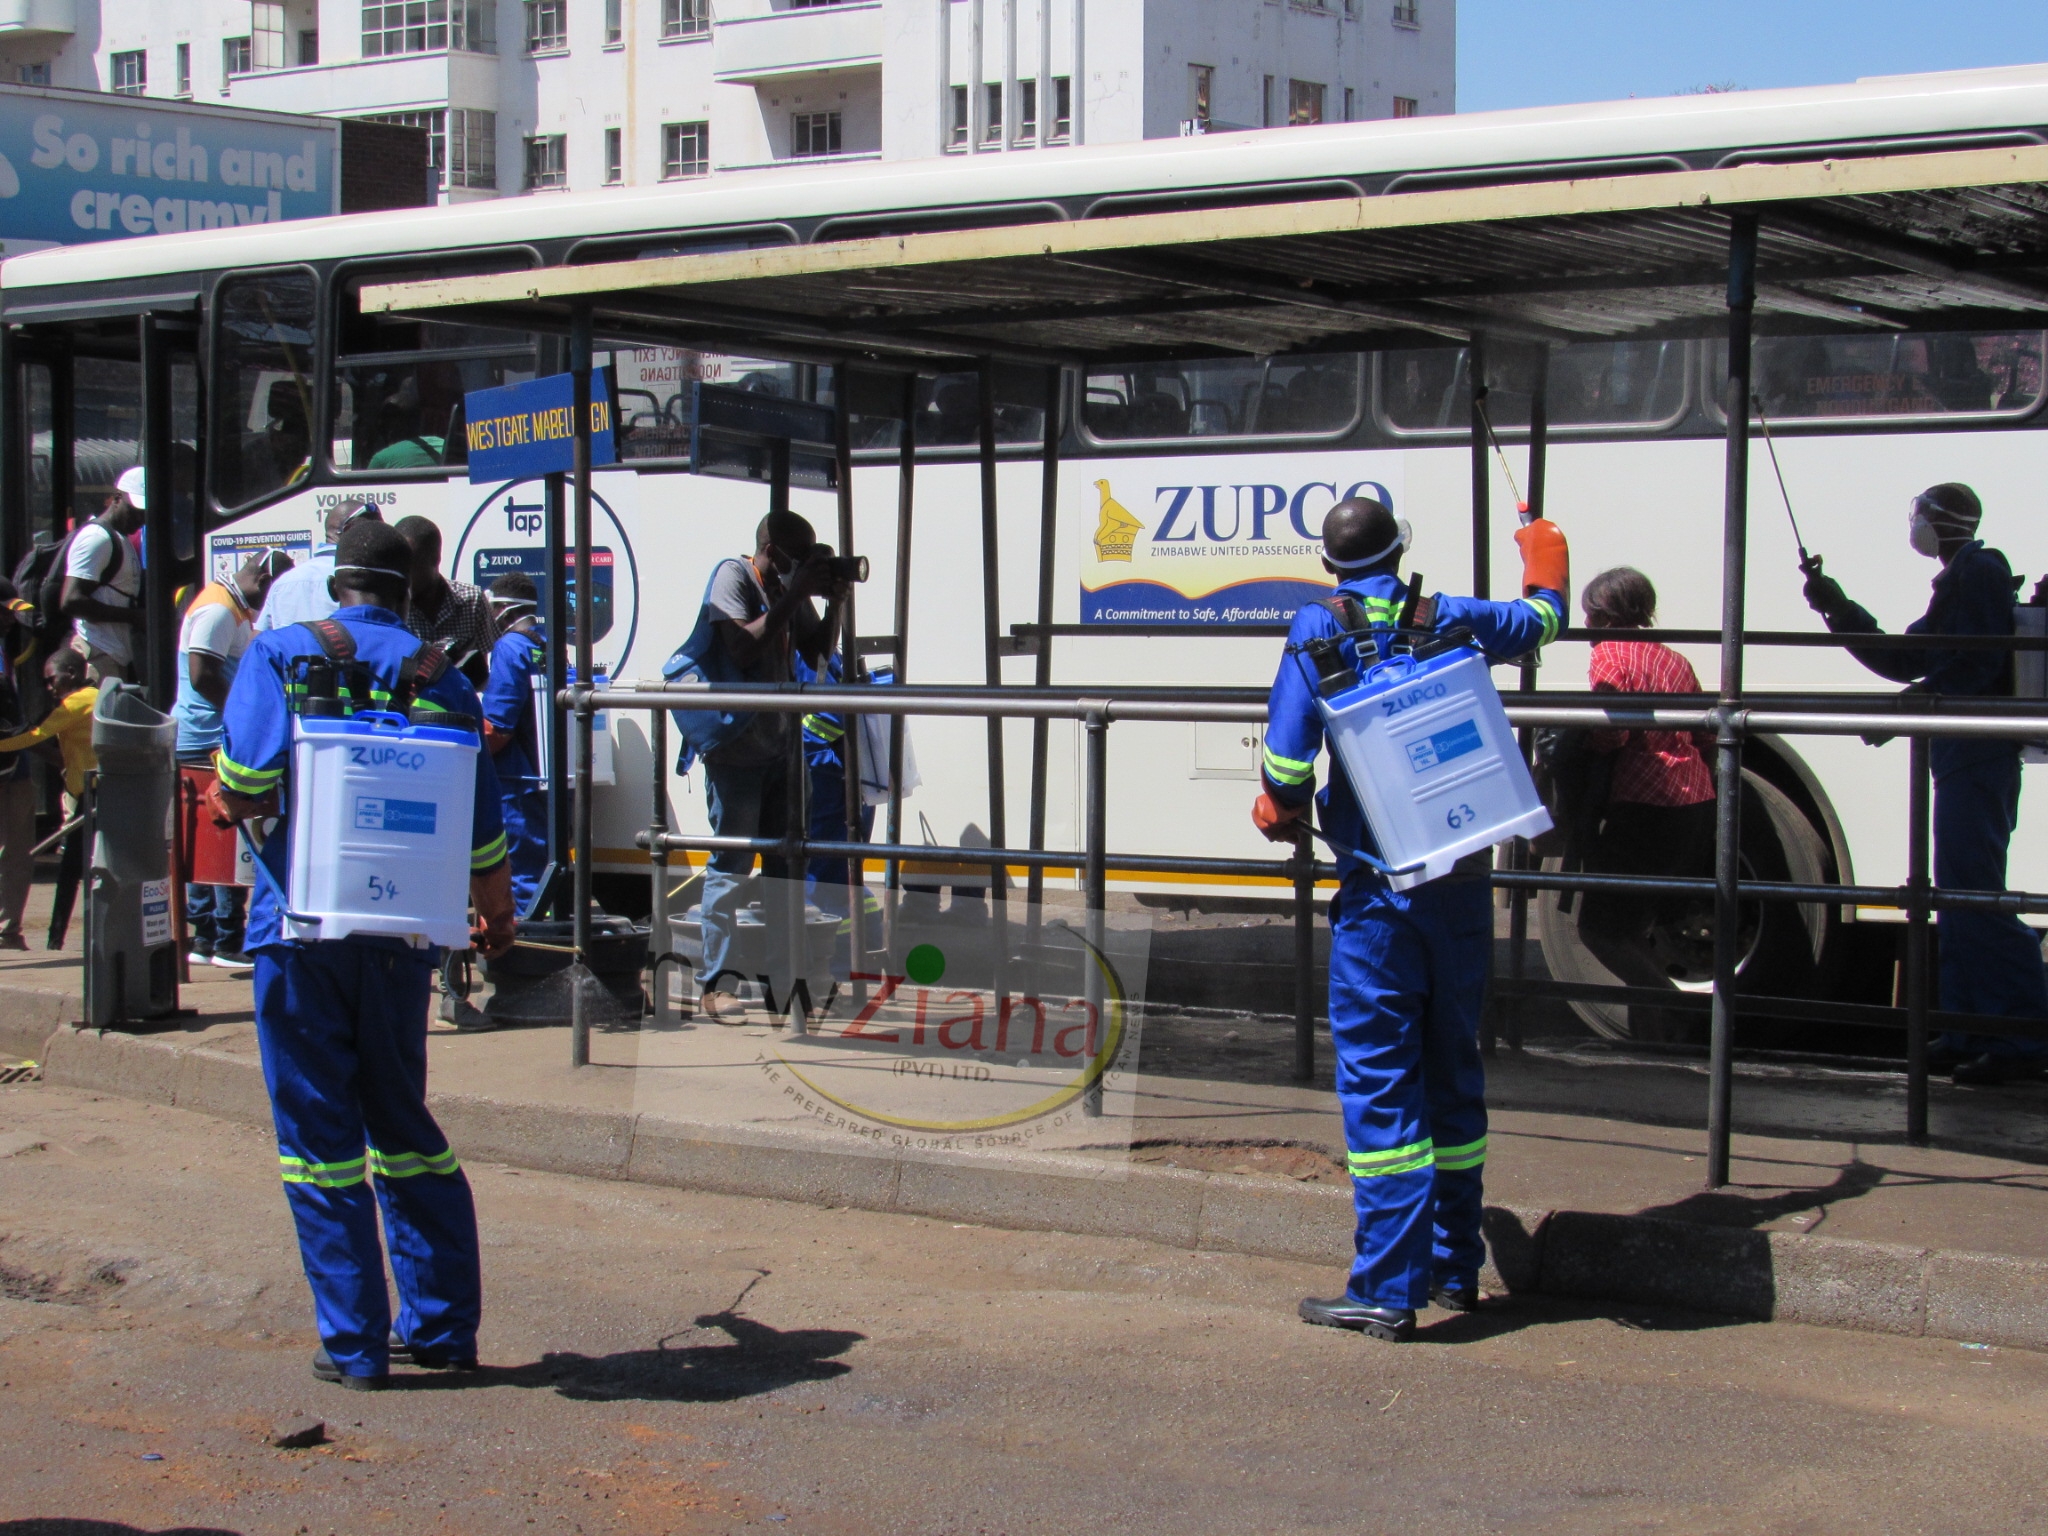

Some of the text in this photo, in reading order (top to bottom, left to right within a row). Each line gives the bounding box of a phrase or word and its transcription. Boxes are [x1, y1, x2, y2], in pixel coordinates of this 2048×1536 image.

[31, 114, 316, 193] So rich and
[466, 401, 609, 452] WESTGATE MABELGN
[504, 496, 544, 537] tap
[213, 537, 243, 547] COVID-19
[244, 534, 286, 545] PREVENTION
[286, 532, 312, 542] GUIDES
[1151, 547, 1207, 557] ZIMBABWE
[1210, 546, 1249, 556] UNITED
[1252, 545, 1312, 556] PASSENGER
[491, 556, 522, 566] ZUPCO
[1094, 608, 1103, 620] A
[1105, 608, 1176, 620] Commitment
[1178, 609, 1190, 620] to
[1193, 607, 1219, 622] Safe,
[1222, 607, 1279, 622] Affordable
[1382, 683, 1447, 717] ZUPCO
[351, 746, 426, 771] ZUPCO
[1446, 803, 1476, 829] 63
[368, 875, 399, 901] 54
